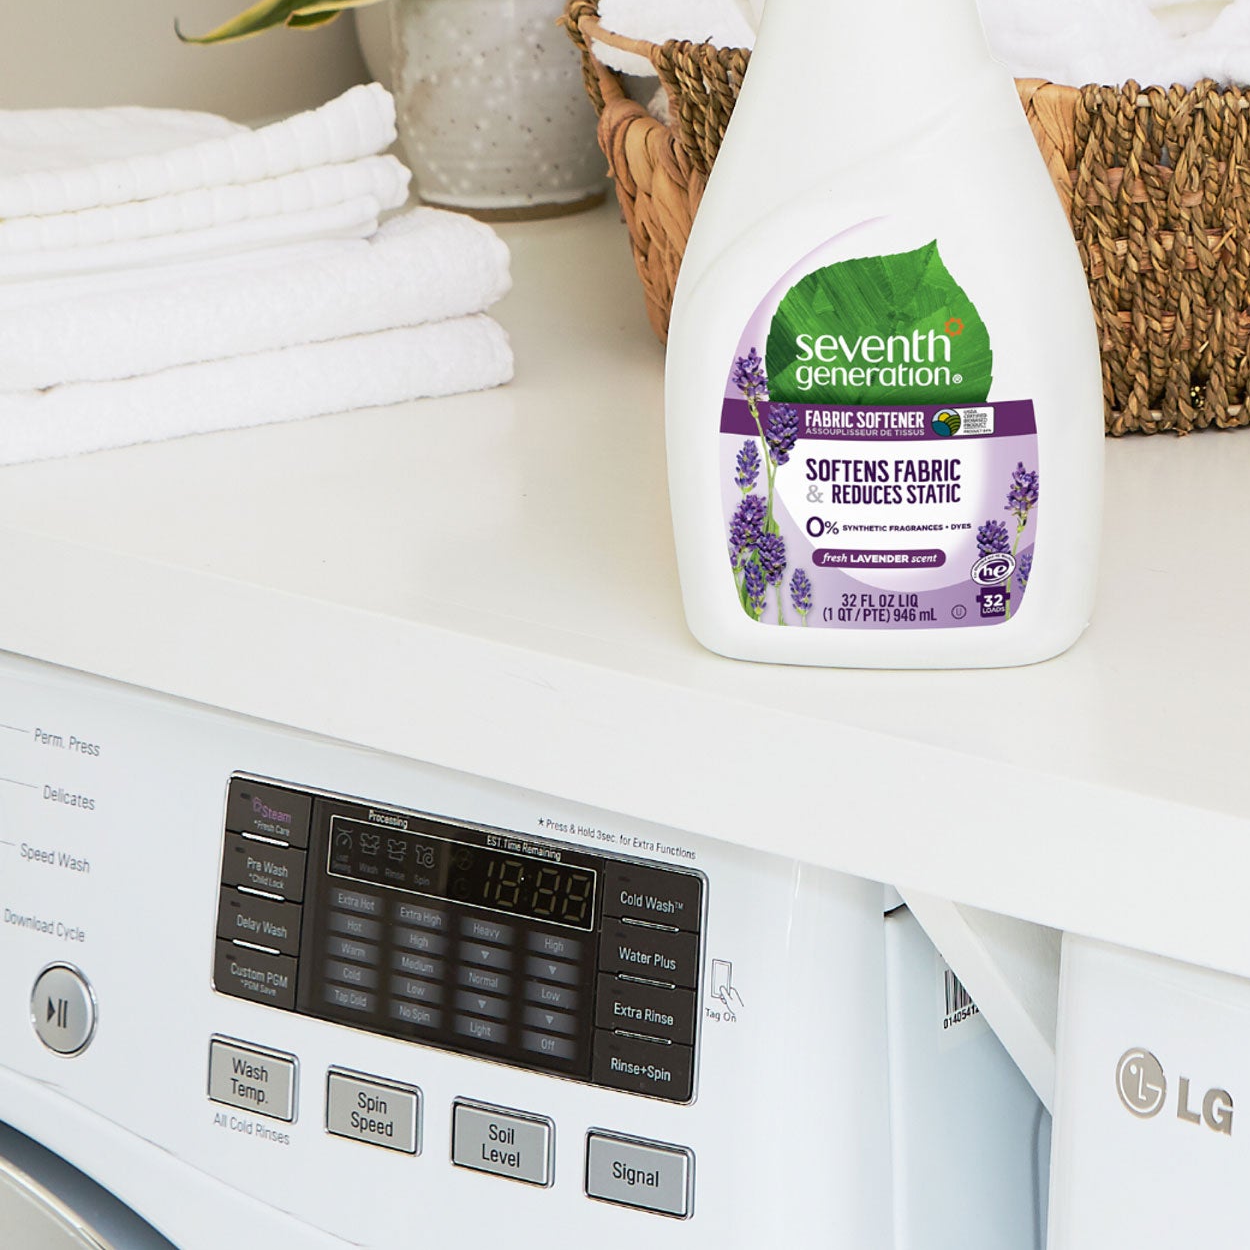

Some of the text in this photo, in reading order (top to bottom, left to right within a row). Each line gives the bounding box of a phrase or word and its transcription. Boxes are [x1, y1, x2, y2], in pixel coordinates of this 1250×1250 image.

[795, 329, 951, 363] seventh
[805, 410, 925, 430] FABRIC SOFTENER
[805, 428, 925, 437] ASSOUPLISSEUR DE TISSUS
[805, 458, 961, 483] SOFTENS FABRIC
[805, 483, 961, 504] & REDUCES STATIC
[806, 516, 840, 538] 0%
[842, 524, 888, 532] SYNTHETIC
[889, 524, 944, 532] FRAGRANCES
[820, 553, 938, 565] fresh LAVENDER scent
[983, 565, 1007, 579] he
[842, 594, 919, 609] 32 FL OZ LIQ
[983, 594, 1004, 608] 32
[822, 608, 833, 622] (1
[893, 608, 916, 622] 946
[919, 608, 938, 621] mL
[34, 728, 101, 757] Perm. Press
[43, 784, 96, 811] Delicates
[262, 805, 292, 824] Steam
[368, 809, 408, 830] Processing
[546, 818, 568, 834] Press
[570, 824, 576, 835] &
[577, 825, 595, 839] Hold
[619, 835, 631, 847] for
[633, 837, 655, 851] Extra
[656, 842, 697, 861] Functions
[20, 842, 91, 874] Speed Wash
[246, 857, 289, 879] Pre Wash
[338, 893, 376, 912] Extra Hot
[620, 891, 643, 908] Cold
[3, 908, 86, 943] Download Cycle
[237, 913, 288, 940] Delay Wash
[347, 920, 363, 934] Hot
[400, 907, 443, 928] Extra High
[410, 932, 429, 949] High
[473, 923, 501, 941] Heavy
[341, 941, 366, 959] Warm
[544, 937, 564, 954] High
[402, 956, 434, 974] Medium
[619, 945, 677, 971] Water Plus
[230, 961, 289, 990] Custom PGM
[343, 967, 361, 982] Cold
[469, 972, 498, 989] Normal
[406, 982, 426, 997] Low
[541, 988, 561, 1003] Low
[400, 1005, 431, 1024] No Spin
[614, 1002, 674, 1027] Extra Rinse
[705, 1007, 737, 1023] Tag On
[470, 1021, 491, 1039] Light
[541, 1038, 556, 1051] Off
[232, 1056, 269, 1083] Wash
[610, 1057, 672, 1082] Rinse+Spin
[229, 1077, 269, 1106] Temp.
[357, 1091, 388, 1115] Spin
[1176, 1075, 1234, 1137] LG
[213, 1112, 291, 1146] All Cold Rinses
[350, 1111, 394, 1138] Speed
[488, 1123, 515, 1146] Soil
[481, 1142, 521, 1169] Level
[611, 1161, 660, 1188] Signal
